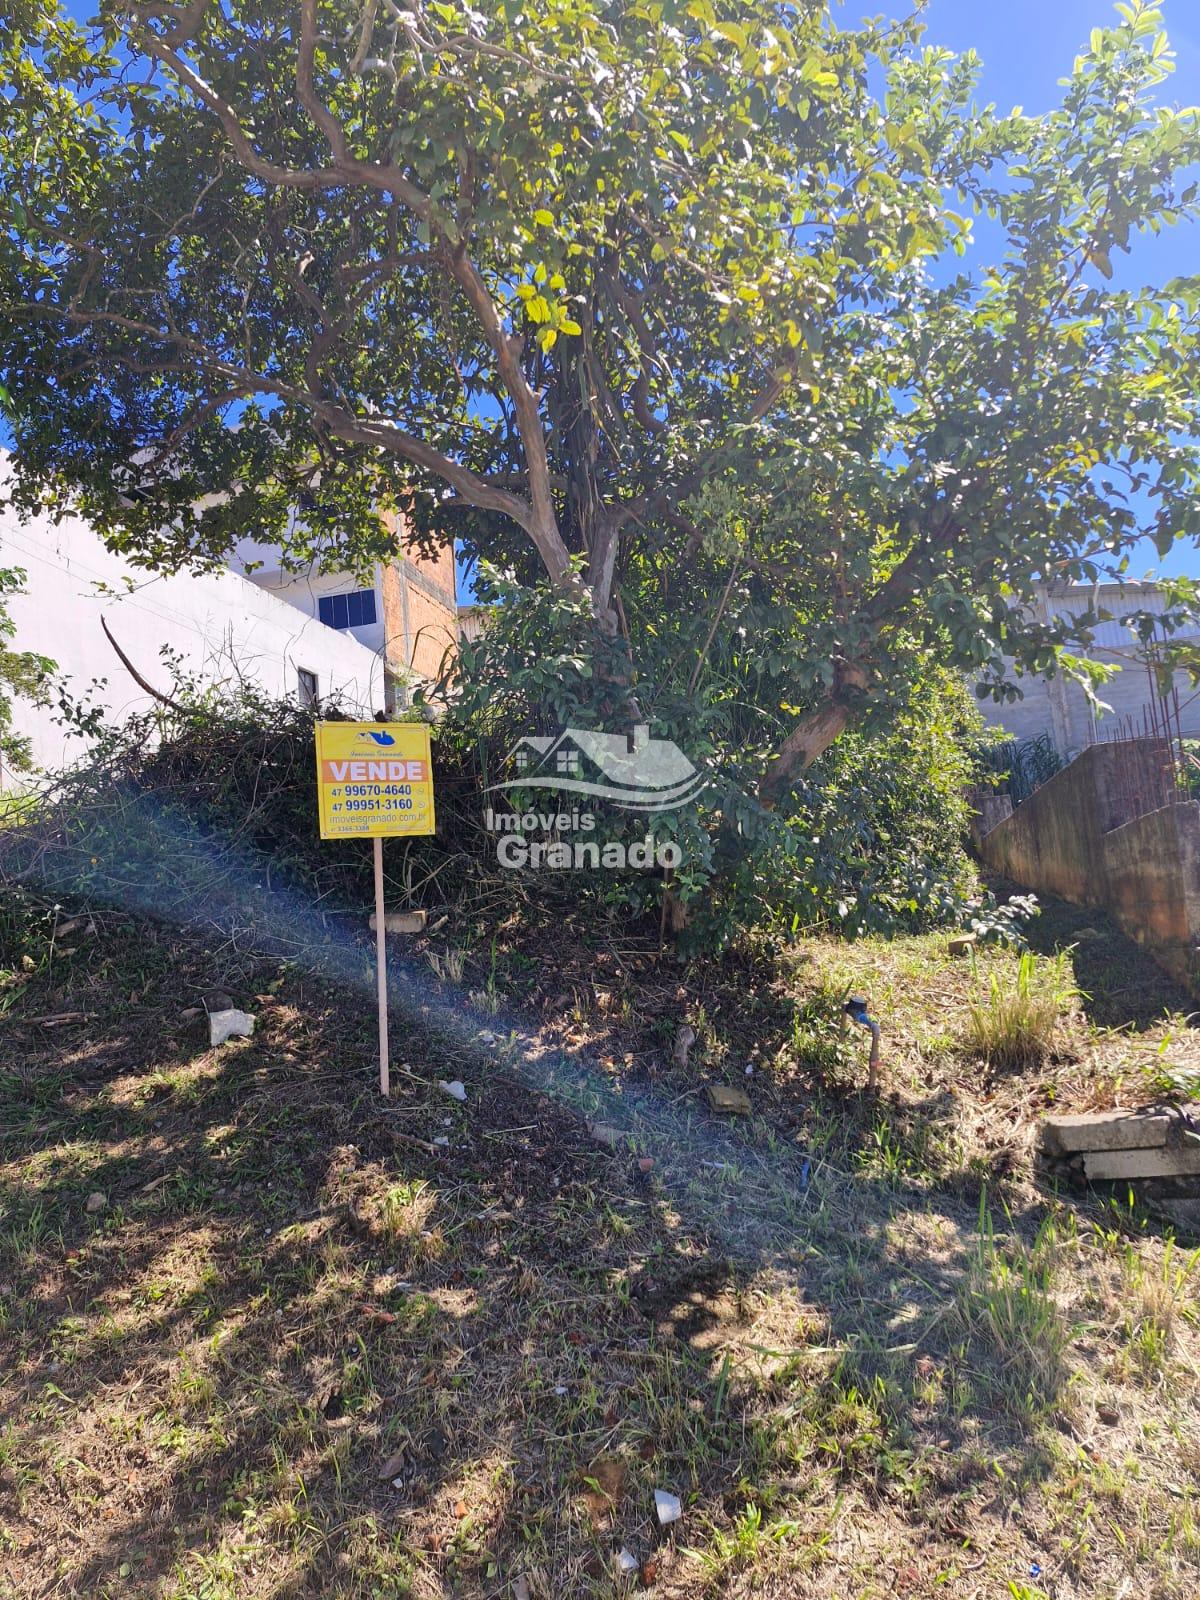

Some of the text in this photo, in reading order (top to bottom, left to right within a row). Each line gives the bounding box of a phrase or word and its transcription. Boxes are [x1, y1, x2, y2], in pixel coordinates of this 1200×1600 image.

[329, 761, 423, 781] VENDE
[331, 784, 412, 796] 47 99670-4640
[332, 798, 412, 812] 47 99951-3160
